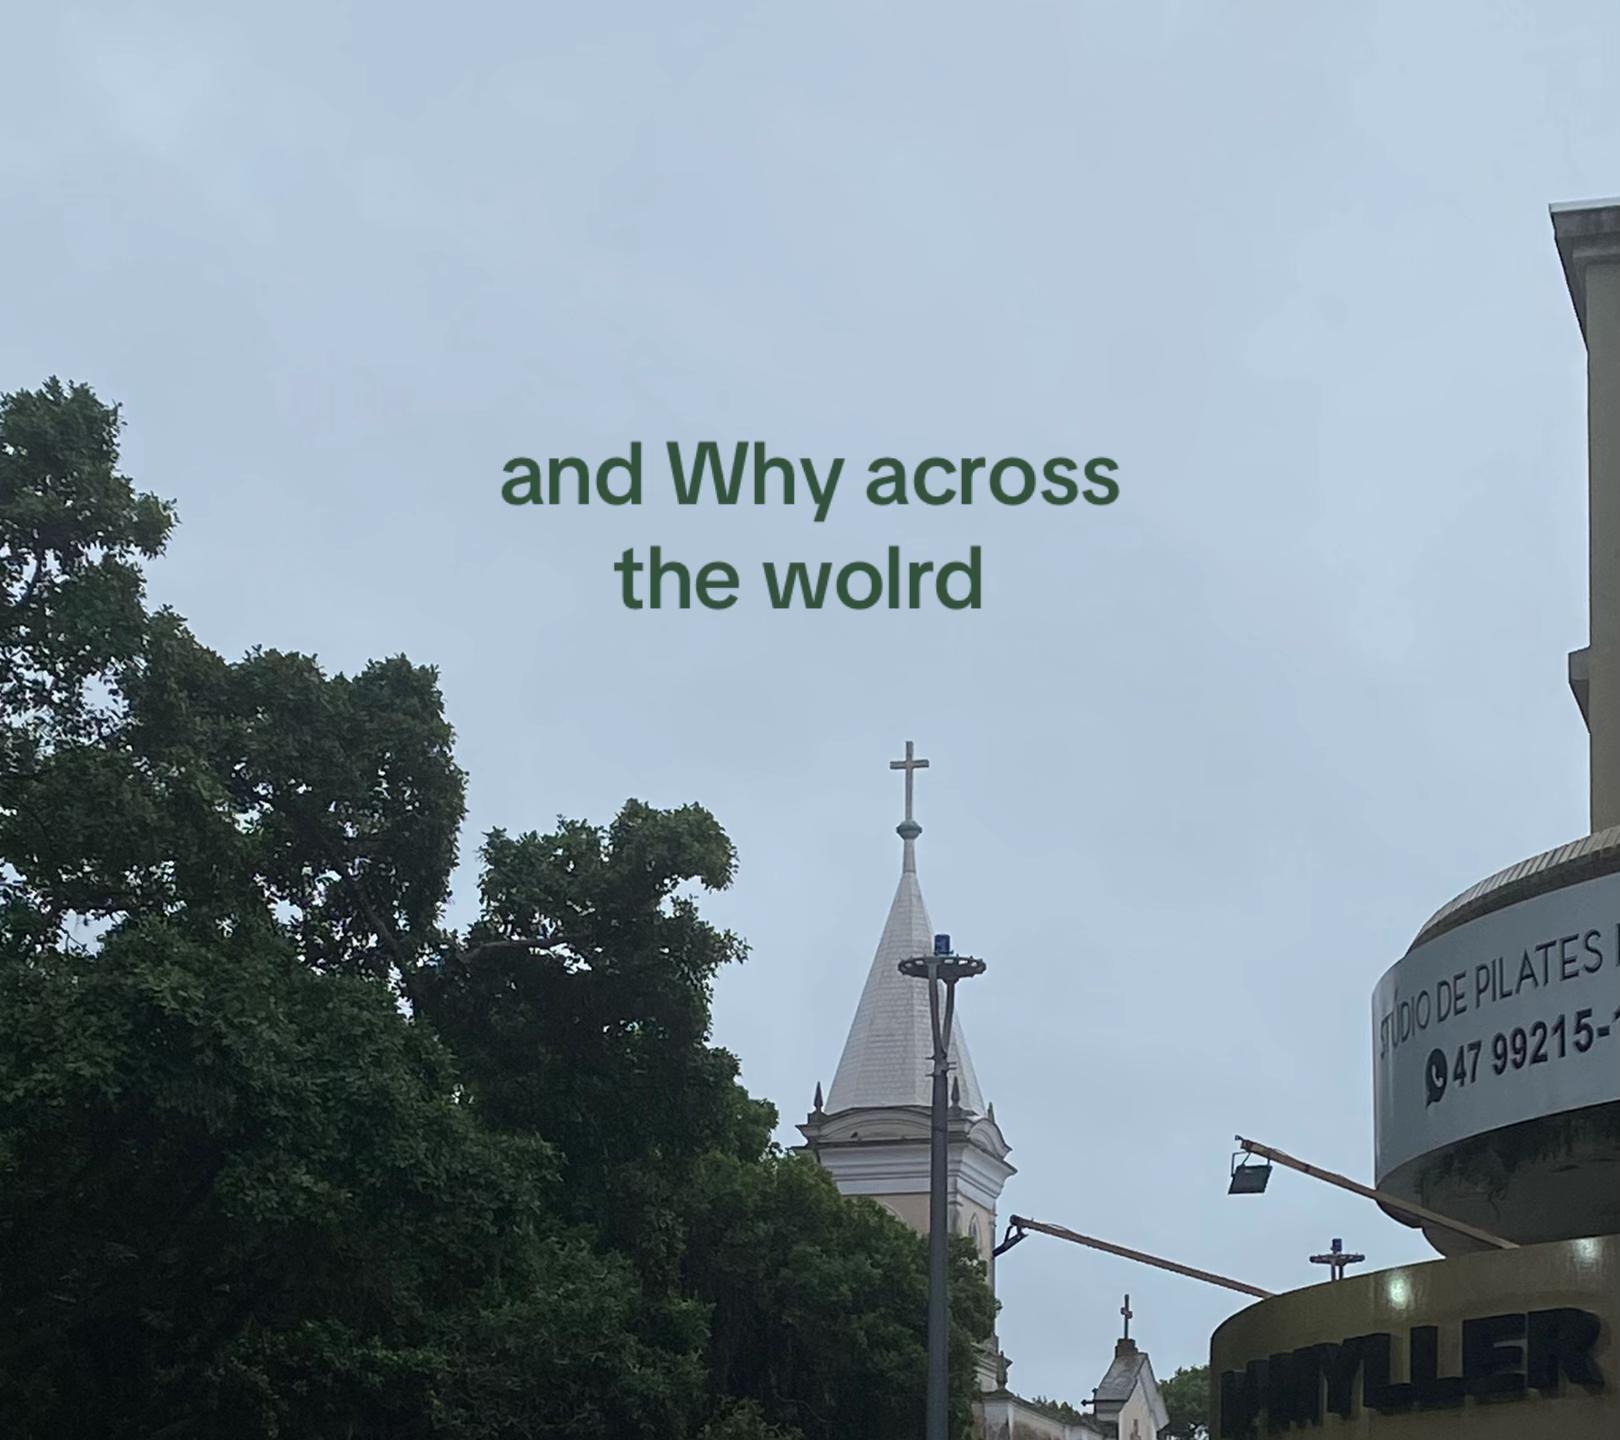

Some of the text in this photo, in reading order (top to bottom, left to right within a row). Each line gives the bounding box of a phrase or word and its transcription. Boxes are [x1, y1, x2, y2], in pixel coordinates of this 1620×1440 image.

[1437, 971, 1467, 1023] DE
[1475, 929, 1603, 1008] PILATES
[1453, 1006, 1620, 1087] 47 99215-
